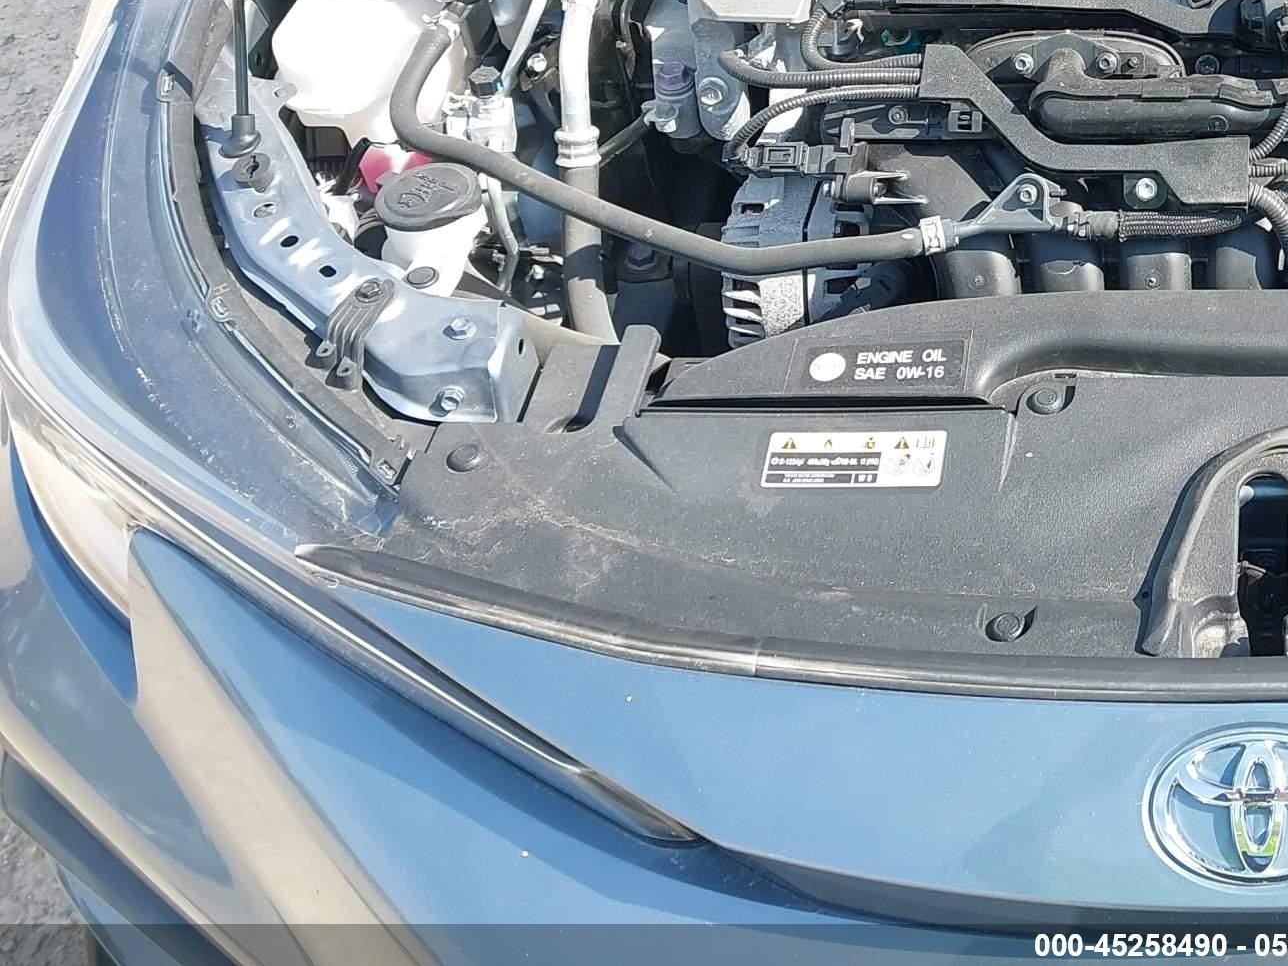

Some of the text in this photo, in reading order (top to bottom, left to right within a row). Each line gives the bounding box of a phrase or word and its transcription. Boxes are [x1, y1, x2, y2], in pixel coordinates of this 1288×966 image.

[856, 348, 947, 365] ENGINE OIL
[853, 365, 945, 381] SAE 0W-16
